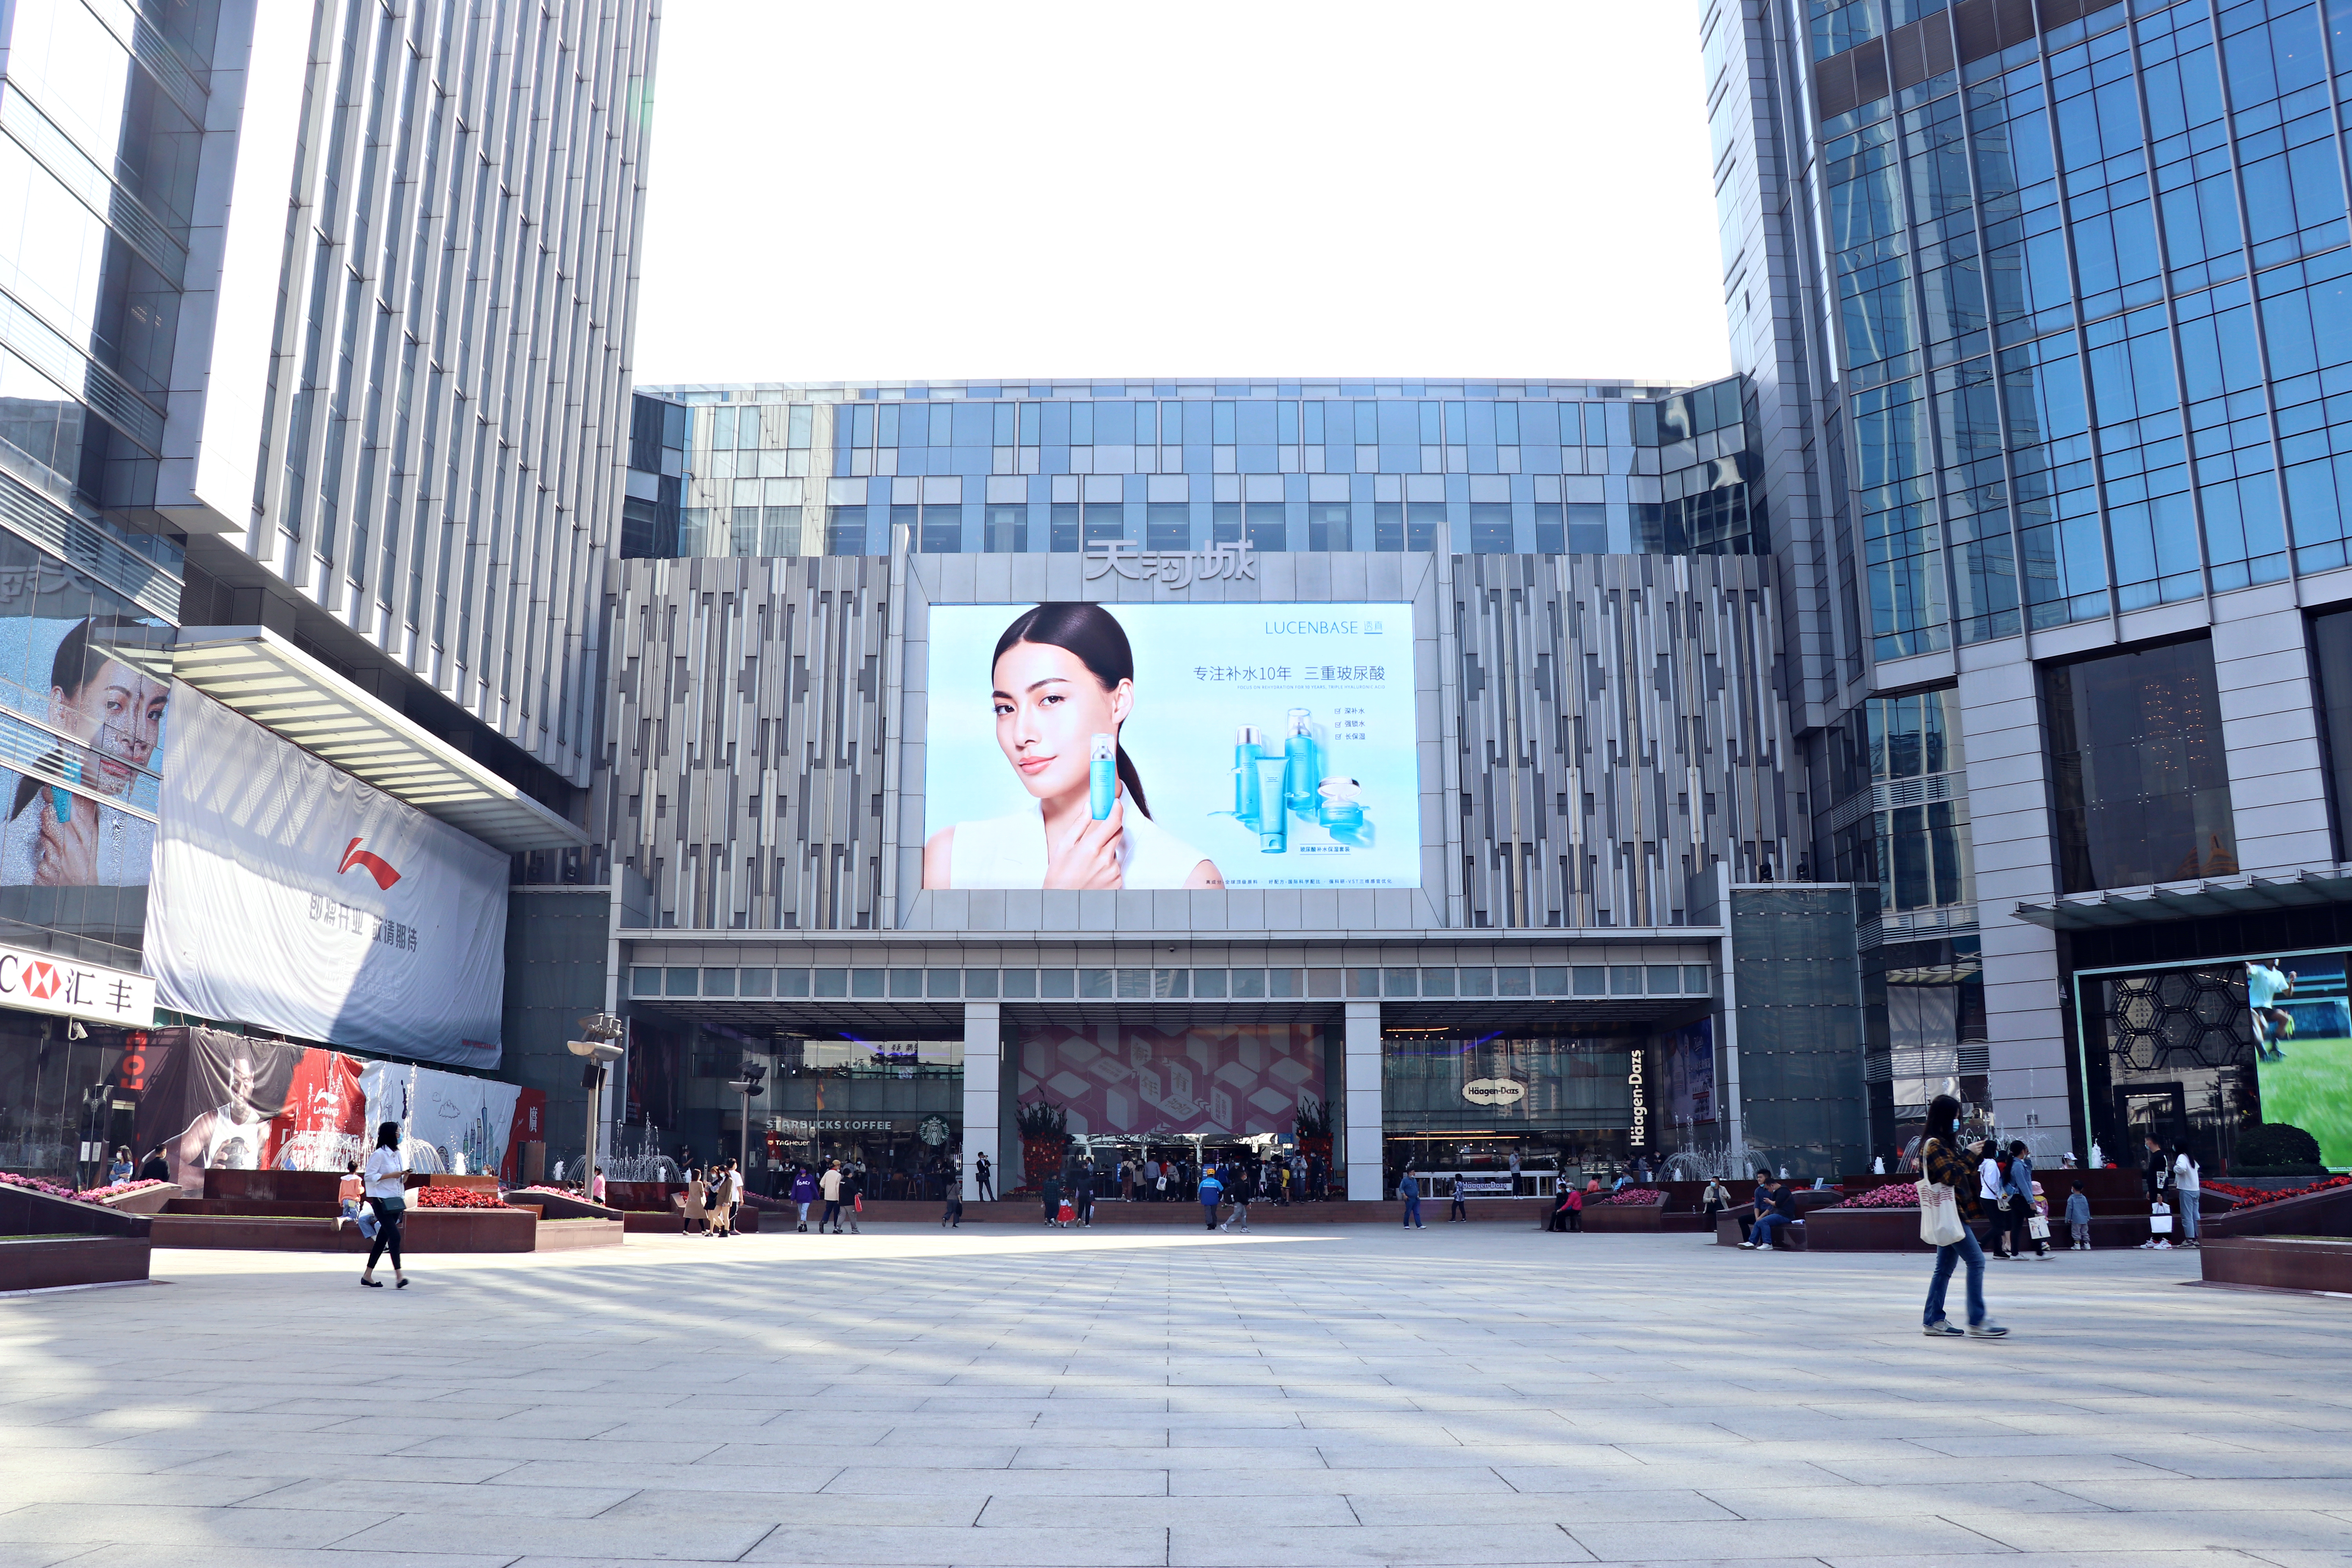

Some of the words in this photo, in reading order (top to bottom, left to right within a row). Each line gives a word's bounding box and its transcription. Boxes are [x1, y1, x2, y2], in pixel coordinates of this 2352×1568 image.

[1086, 539, 1255, 590] 天河城
[1265, 621, 1358, 634] LUCENBASE
[1364, 621, 1383, 631] 透真
[1193, 666, 1292, 681] 专注补水10年
[1304, 665, 1385, 681] 三重玻尿酸
[309, 892, 364, 936] 即将开业
[372, 914, 418, 953] 敬请期待
[66, 968, 132, 1013] 汇丰
[1468, 1087, 1519, 1096] Häagen-Dazs
[1628, 1049, 1648, 1146] Häagen-Dazs
[313, 1106, 339, 1116] LI-NING
[766, 1120, 842, 1131] STARBUCKS
[844, 1120, 892, 1130] COFFEE
[1462, 1181, 1507, 1190] Häagen-Dazs
